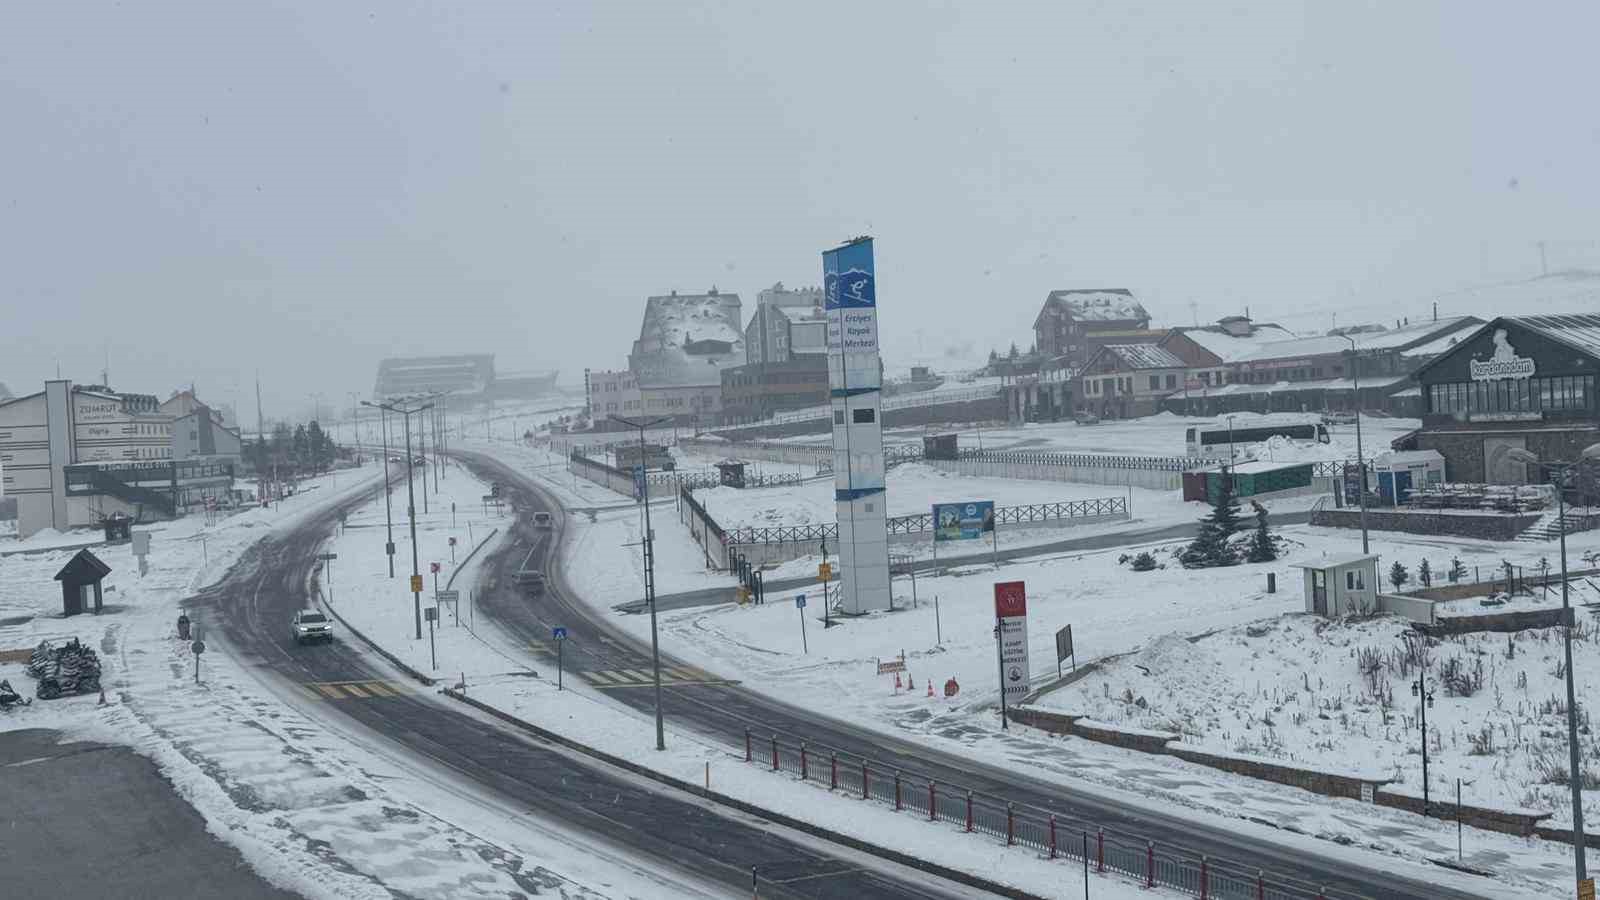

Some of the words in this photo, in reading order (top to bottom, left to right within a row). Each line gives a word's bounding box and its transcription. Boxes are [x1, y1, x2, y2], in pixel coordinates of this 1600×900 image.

[845, 314, 872, 324] Erciyes
[847, 327, 870, 337] Kayak
[844, 338, 875, 348] Merkezi
